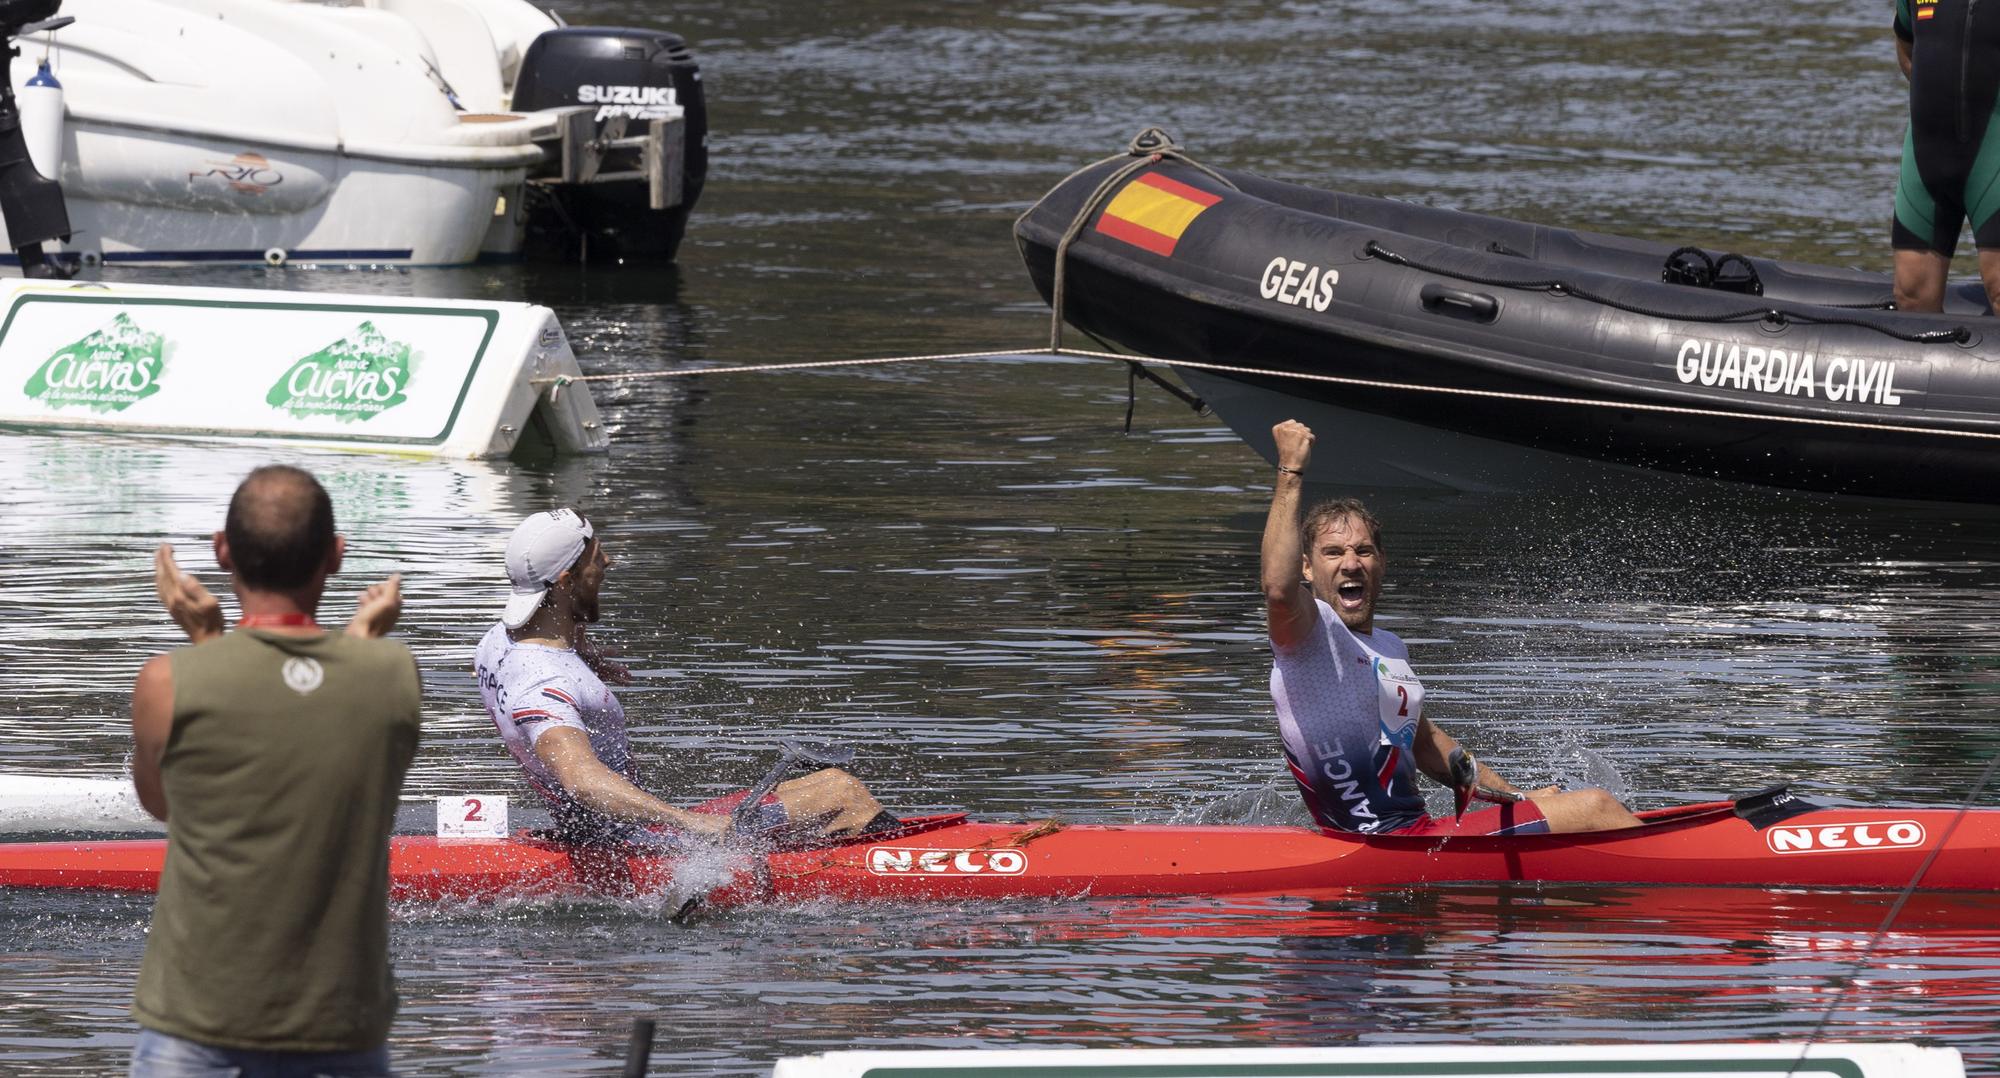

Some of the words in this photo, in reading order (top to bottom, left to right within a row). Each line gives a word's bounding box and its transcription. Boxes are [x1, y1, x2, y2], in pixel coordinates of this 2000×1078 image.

[578, 85, 676, 105] SUZUKI
[1260, 256, 1339, 312] GEAS
[1676, 339, 1815, 398] GUARDIA
[1825, 357, 1901, 406] CIVIL
[478, 664, 508, 714] FRACE
[1397, 685, 1409, 717] 2
[1314, 737, 1380, 835] RANCE
[1773, 793, 1795, 806] FRA
[464, 799, 482, 821] 2
[1773, 823, 1921, 850] NELO
[873, 850, 1023, 872] NELO
